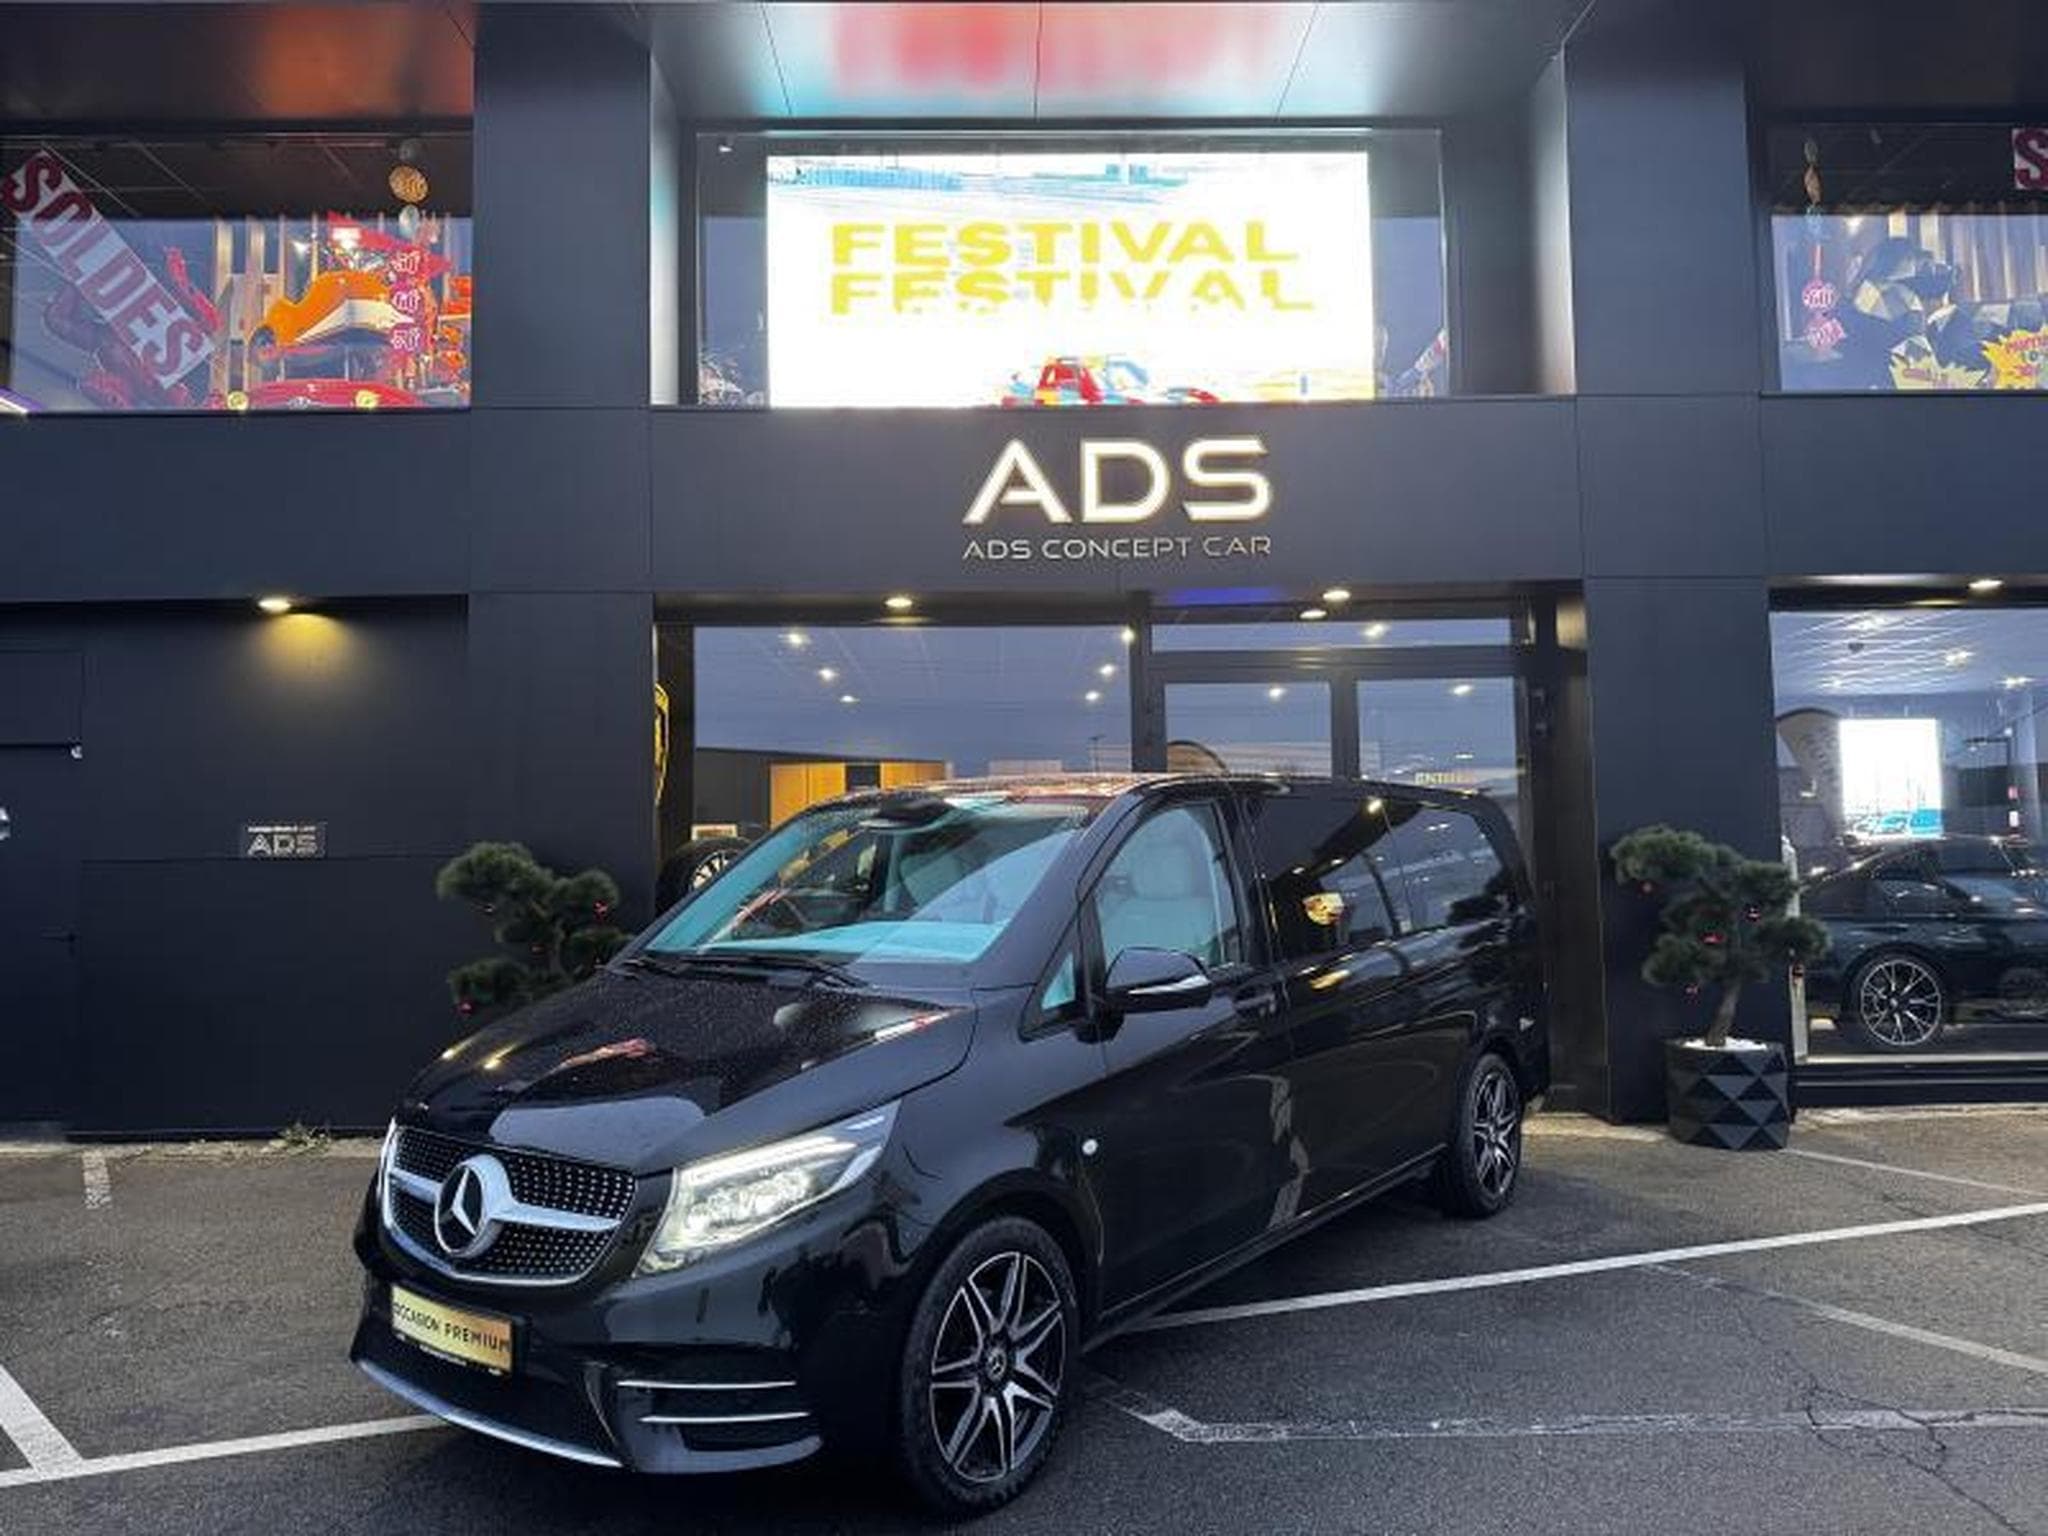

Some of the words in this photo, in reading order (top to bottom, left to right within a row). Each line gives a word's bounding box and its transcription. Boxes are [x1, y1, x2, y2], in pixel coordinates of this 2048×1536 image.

[1, 151, 206, 376] SOLDES
[831, 221, 1298, 266] FESTIVAL
[830, 269, 1314, 314] FESTIVAL
[962, 437, 1272, 524] ADS
[962, 540, 1032, 561] ADS
[1042, 537, 1192, 559] CONCEPT
[1202, 535, 1272, 557] CAR
[247, 834, 318, 856] ADS
[392, 1302, 440, 1332] OCCASION
[444, 1322, 511, 1352] PREMIUM
